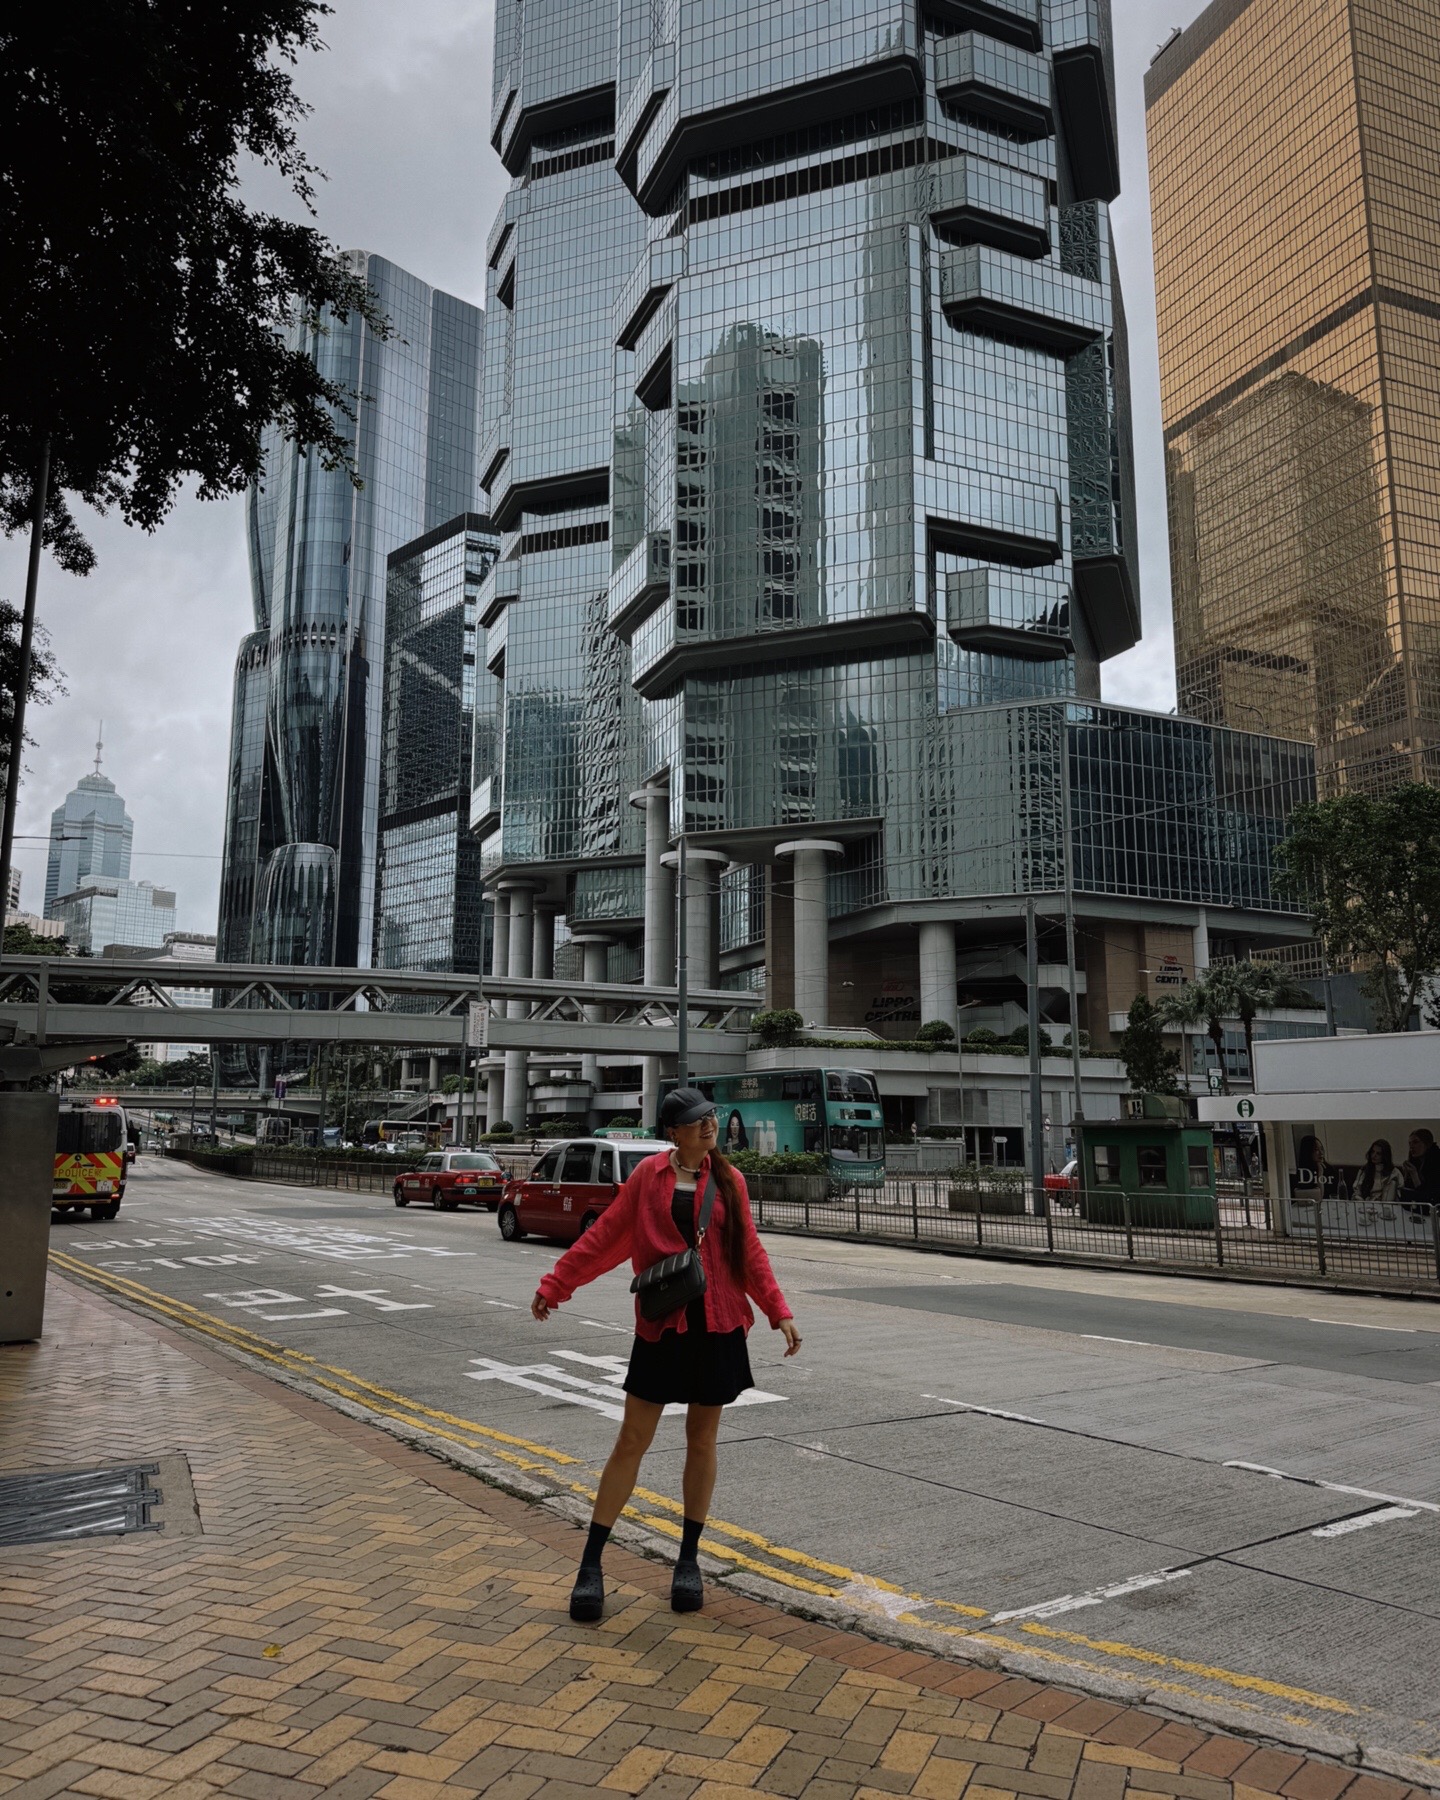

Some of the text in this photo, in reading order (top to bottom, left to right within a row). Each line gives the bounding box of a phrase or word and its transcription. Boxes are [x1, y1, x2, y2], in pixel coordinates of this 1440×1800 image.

[872, 996, 914, 1008] LIPPO
[864, 1010, 921, 1022] CENTRE
[58, 1168, 94, 1178] POLICE
[1297, 1167, 1334, 1185] Dior
[69, 1237, 196, 1251] BUS
[294, 1243, 477, 1260] 巴士
[97, 1253, 263, 1273] STOP
[203, 1284, 436, 1321] 巴士
